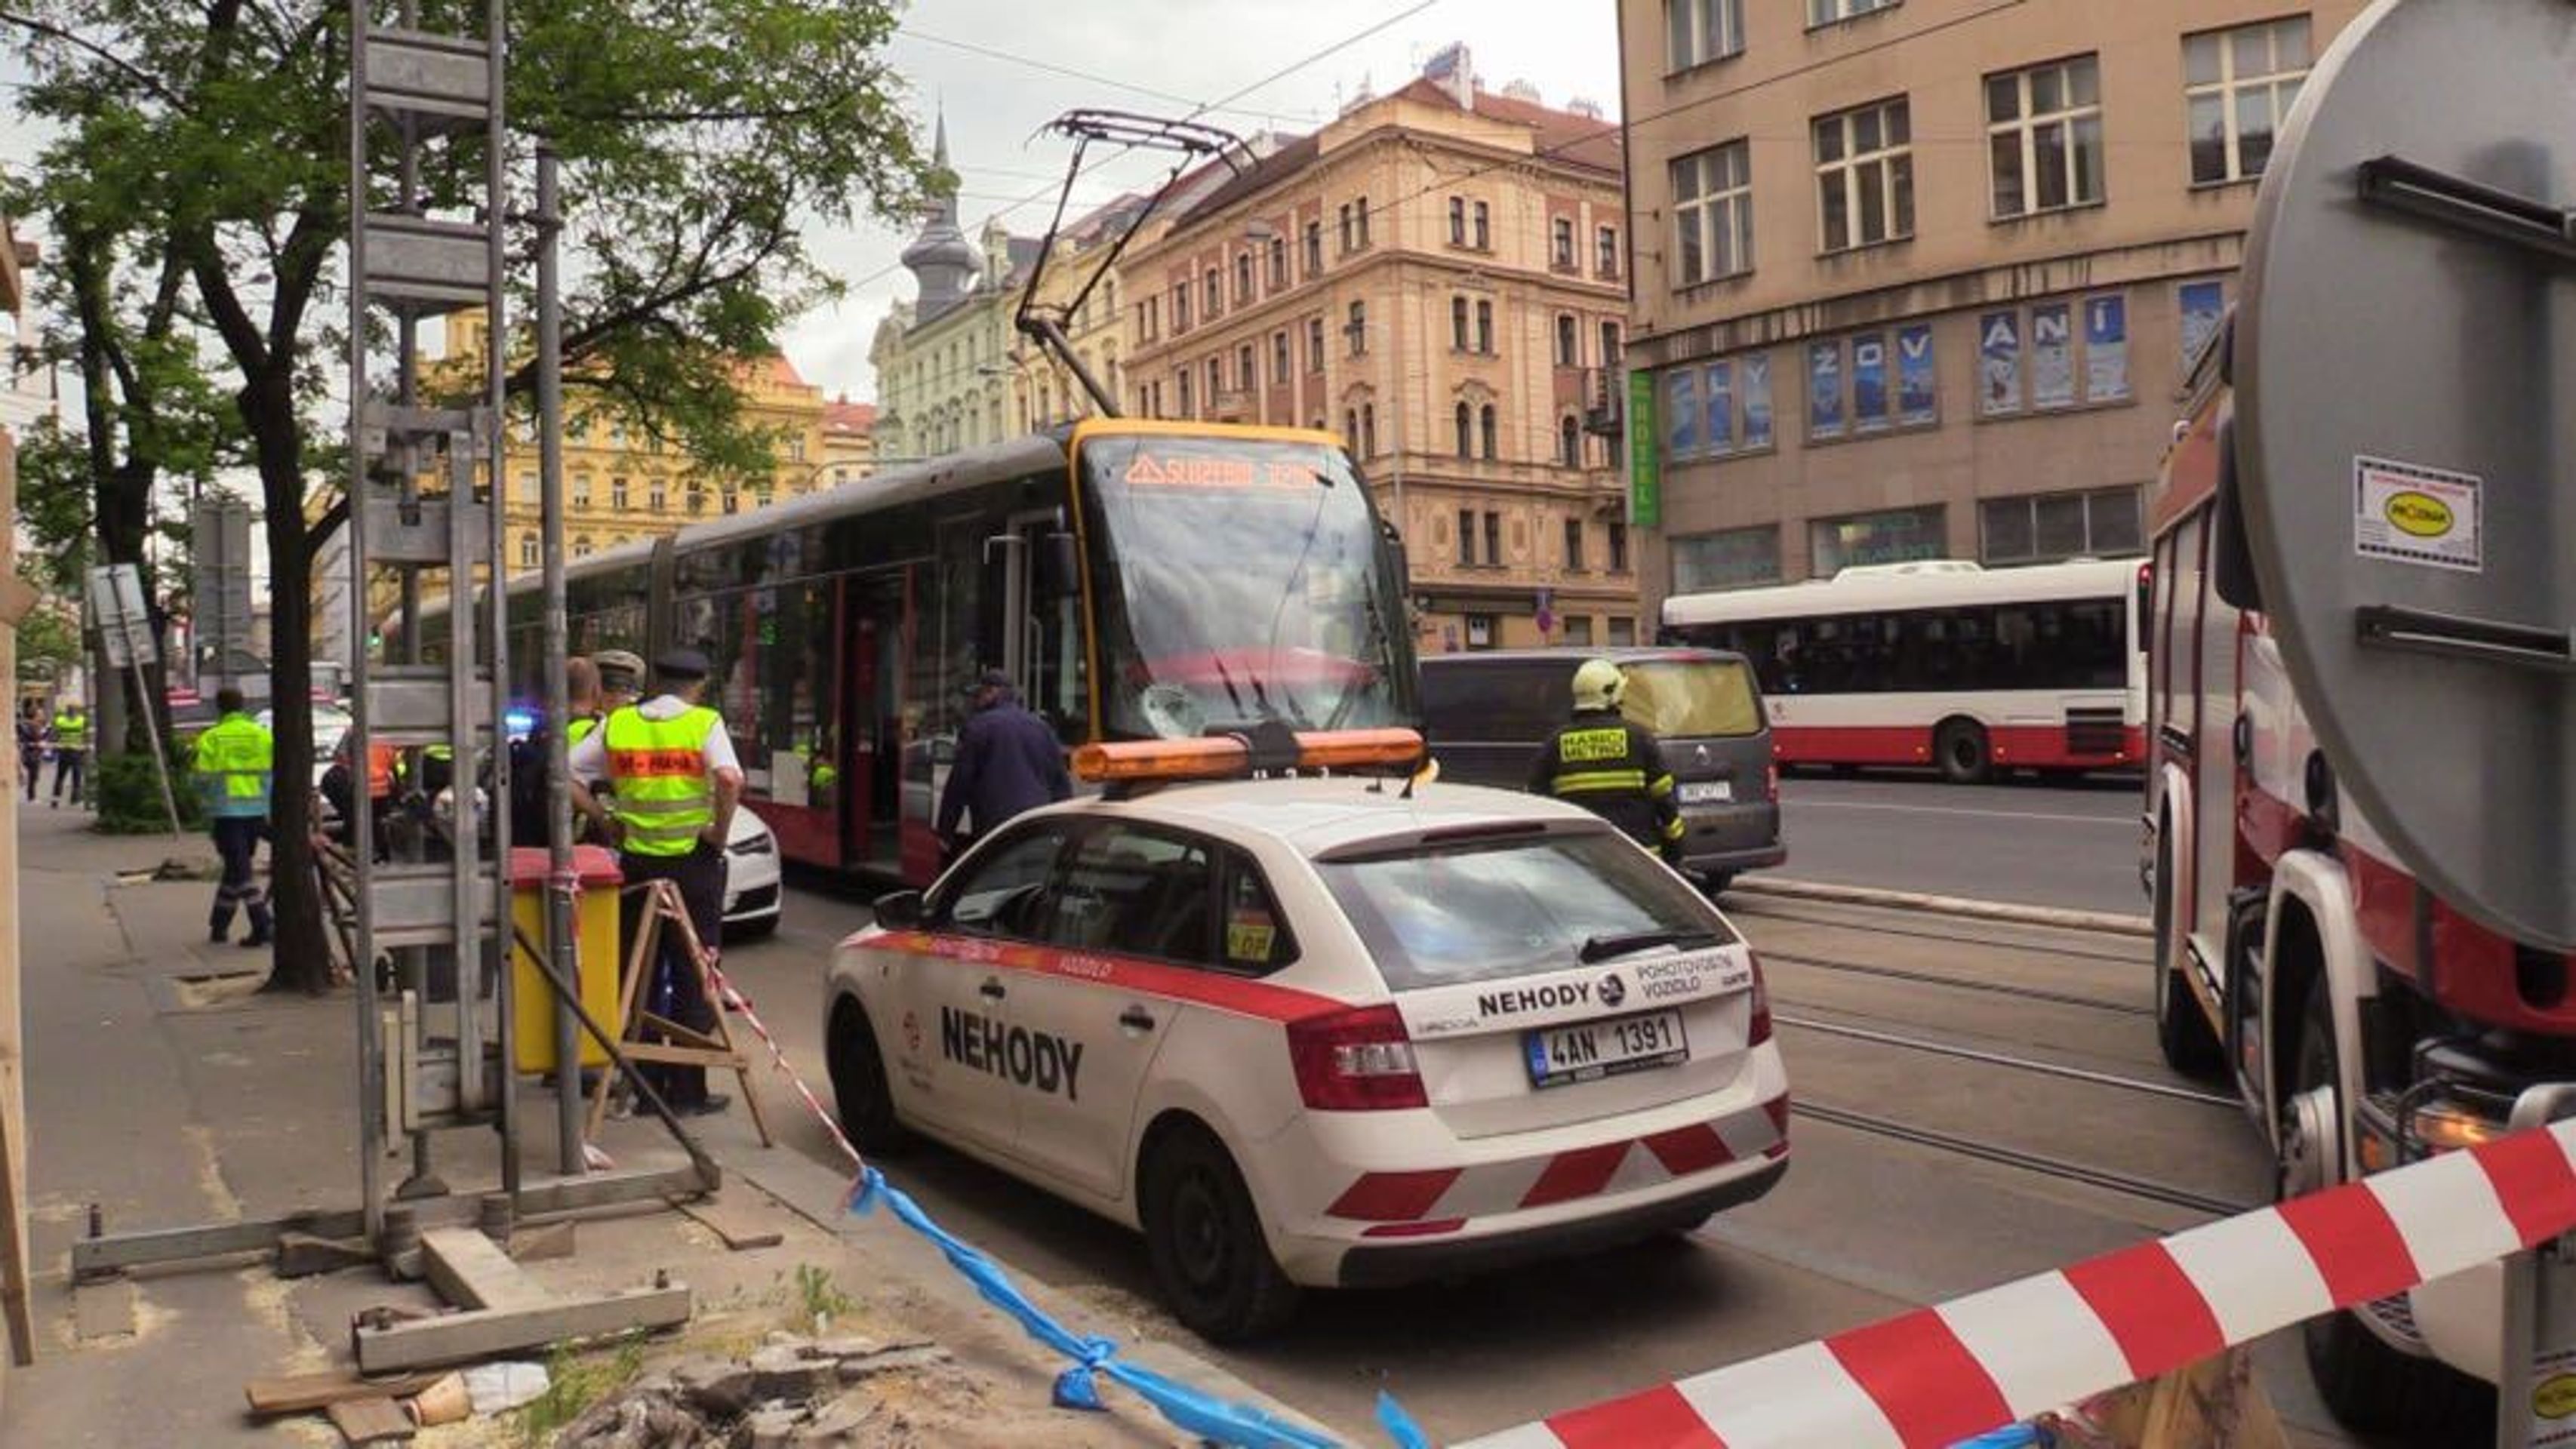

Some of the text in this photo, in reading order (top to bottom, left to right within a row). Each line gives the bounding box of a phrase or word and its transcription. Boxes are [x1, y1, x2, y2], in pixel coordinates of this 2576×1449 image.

[1478, 982, 1590, 1017] NEHODY
[941, 1005, 1085, 1101] NEHODY
[1551, 1017, 1673, 1066] 4AN 1391
